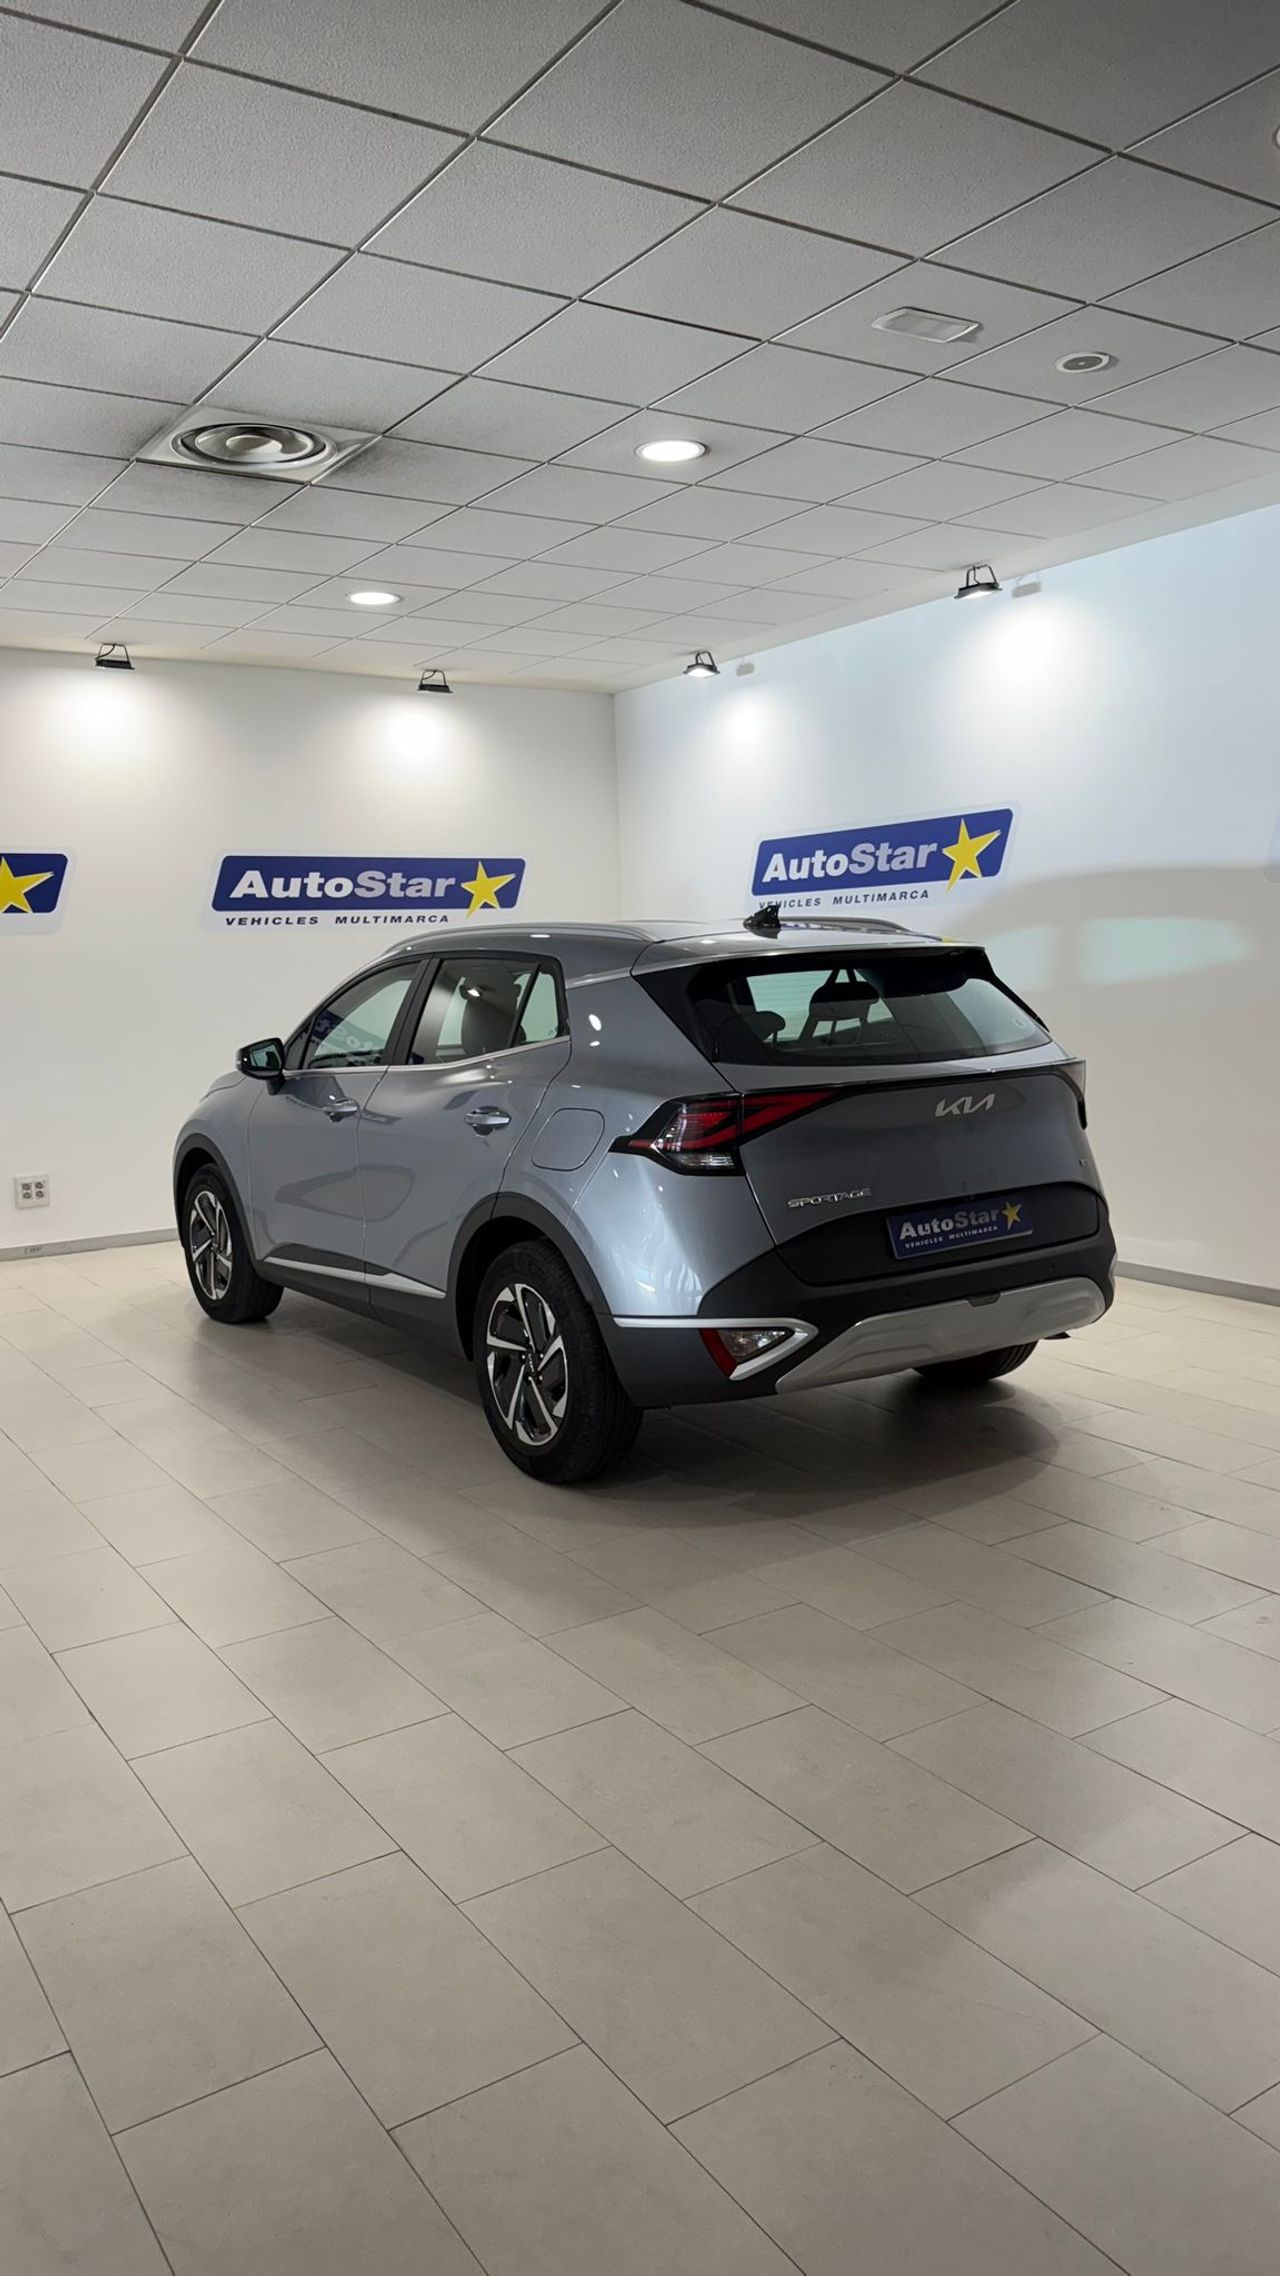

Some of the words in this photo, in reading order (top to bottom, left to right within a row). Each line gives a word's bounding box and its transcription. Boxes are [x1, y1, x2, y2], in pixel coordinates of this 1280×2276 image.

[762, 842, 938, 883] AutoStar
[229, 870, 456, 899] AutoStar
[832, 890, 929, 906] MULTIMARCA
[225, 916, 319, 926] VEHICLES
[335, 915, 449, 925] MULTIMARCA
[935, 1093, 996, 1117] KIA
[787, 1187, 871, 1208] SPORTAGE
[900, 1209, 999, 1240] AutoStar
[948, 1225, 998, 1240] MULTIMARCA
